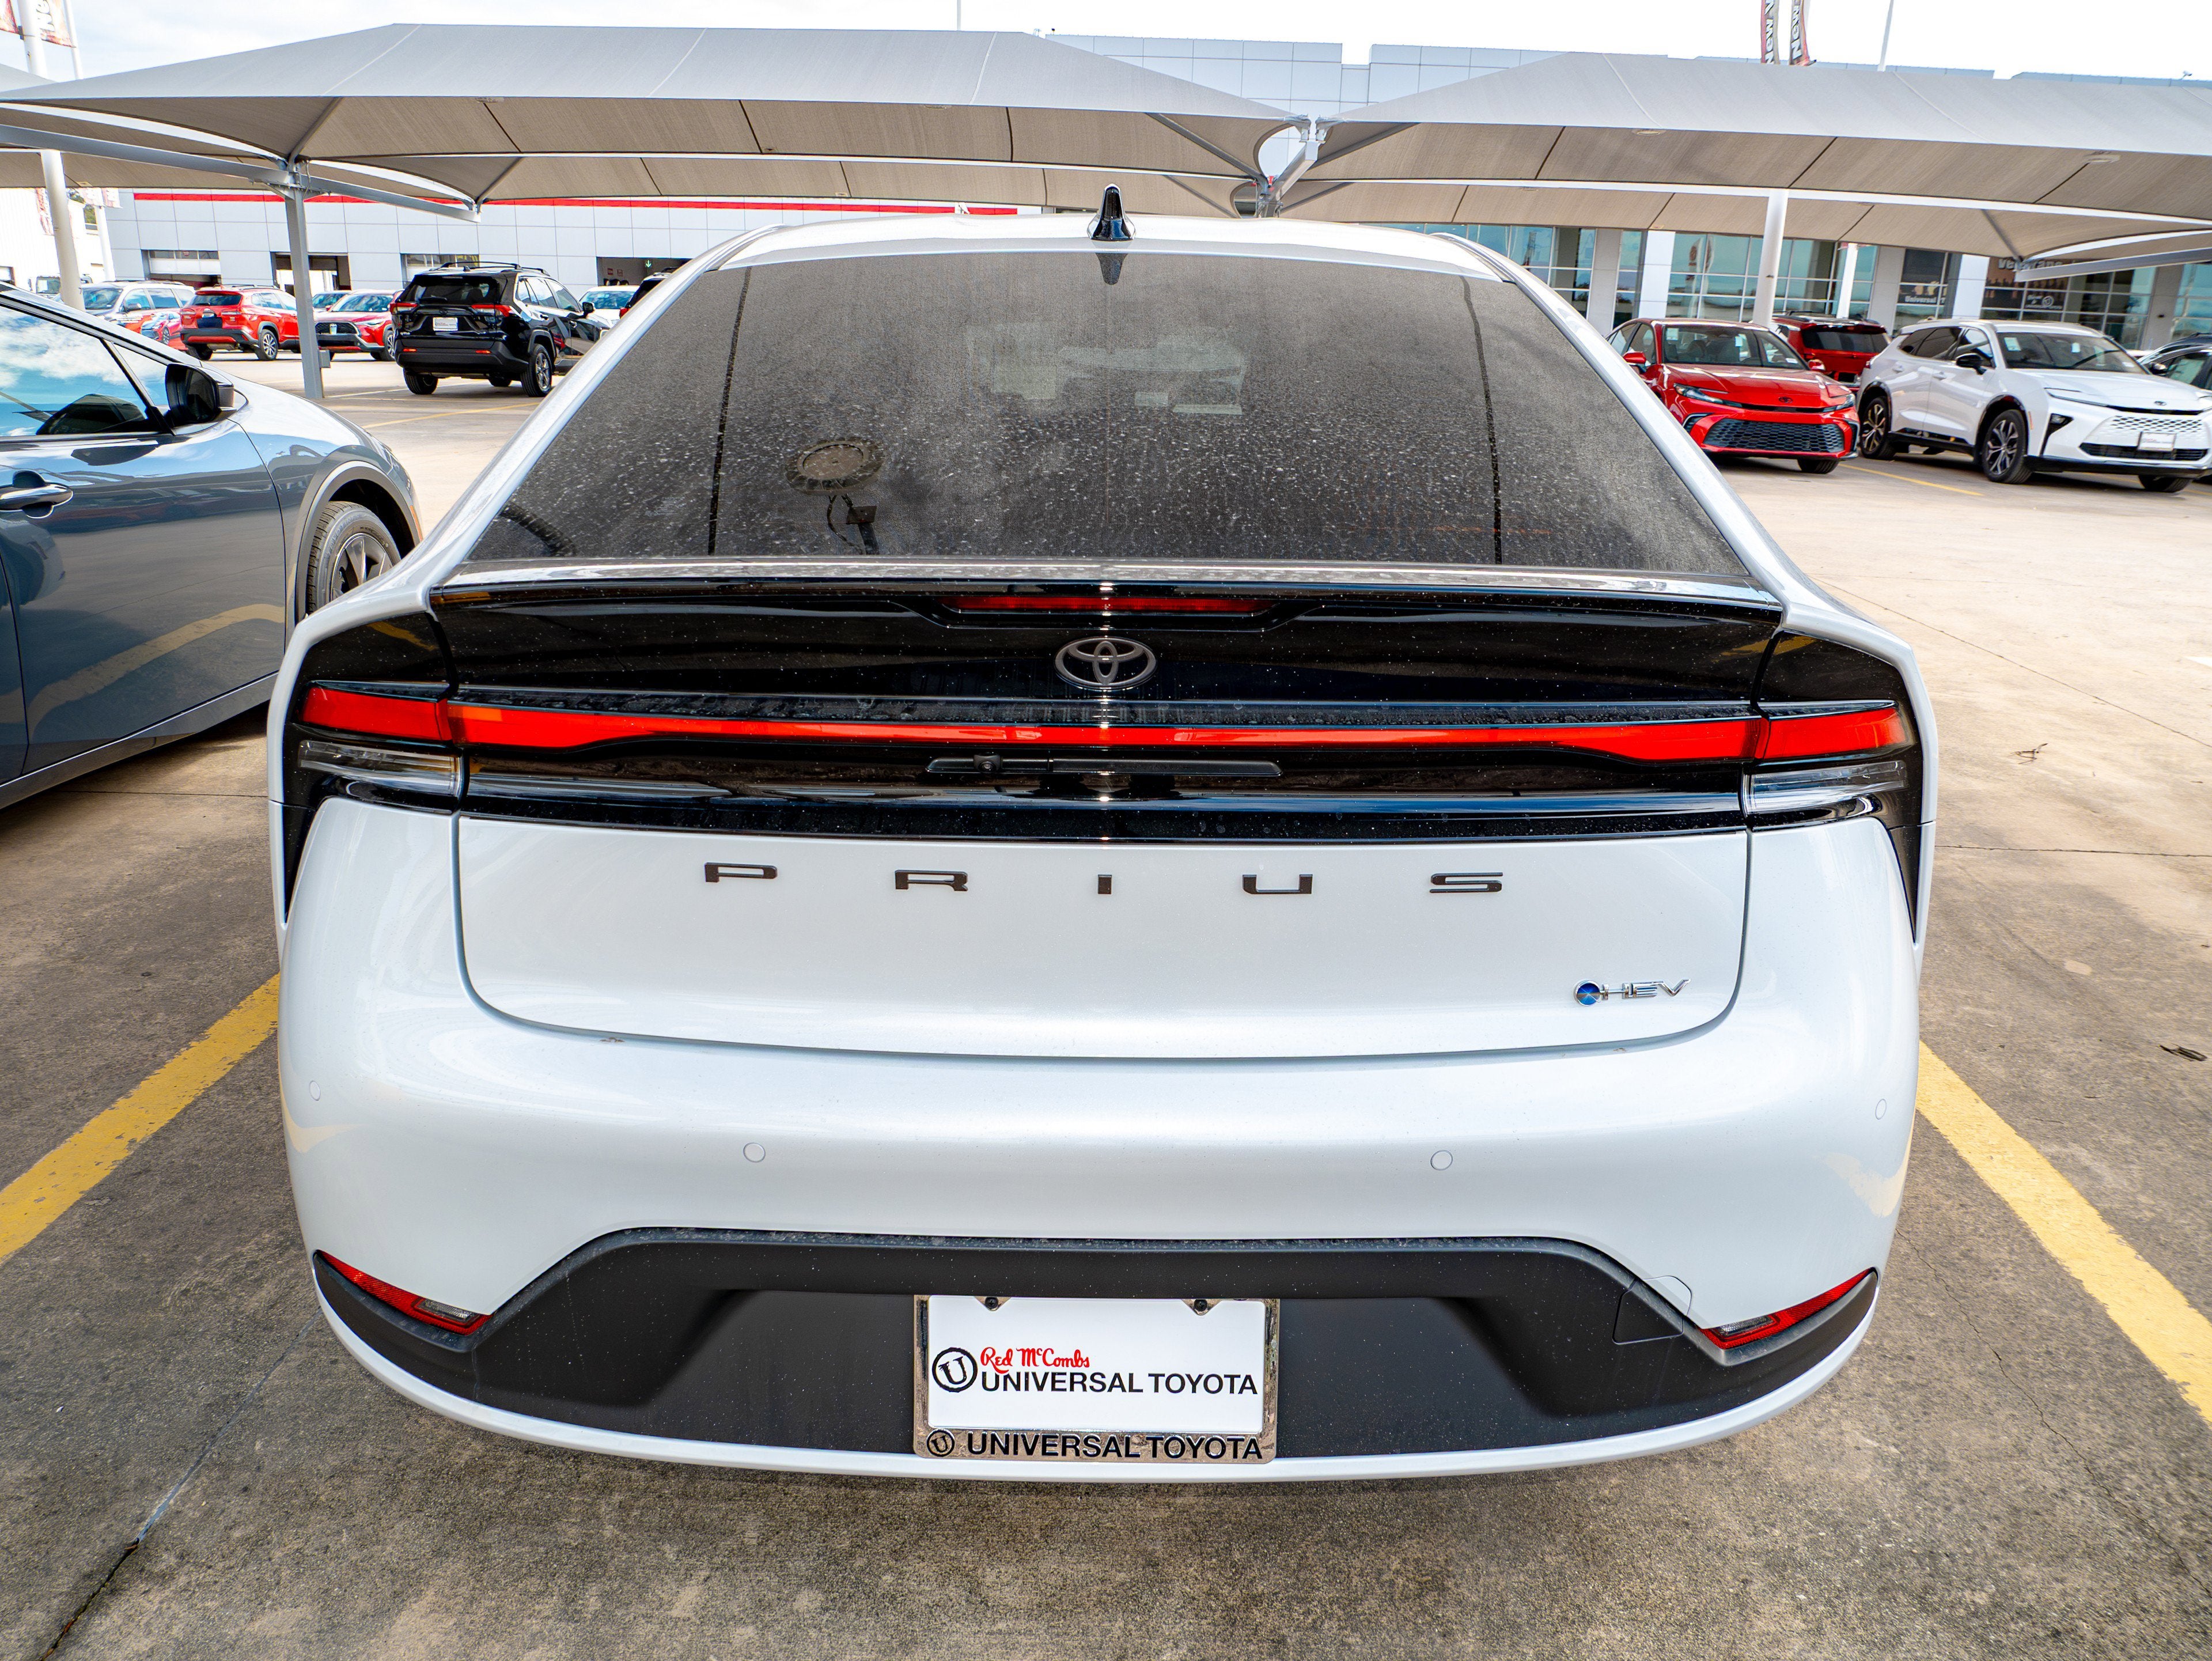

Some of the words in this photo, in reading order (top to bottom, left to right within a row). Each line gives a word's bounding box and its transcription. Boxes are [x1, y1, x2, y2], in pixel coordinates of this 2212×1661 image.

[1764, 18, 1774, 65] New
[1791, 5, 1802, 59] New
[704, 862, 1503, 895] PRIUS
[980, 1347, 1013, 1374] Red
[1016, 1348, 1090, 1368] McCombs
[982, 1371, 1143, 1393] UNIVERSAL
[1148, 1374, 1258, 1395] TOYOTA
[967, 1431, 1141, 1458] UNIVERSAL
[1146, 1435, 1263, 1459] TOYOTA
